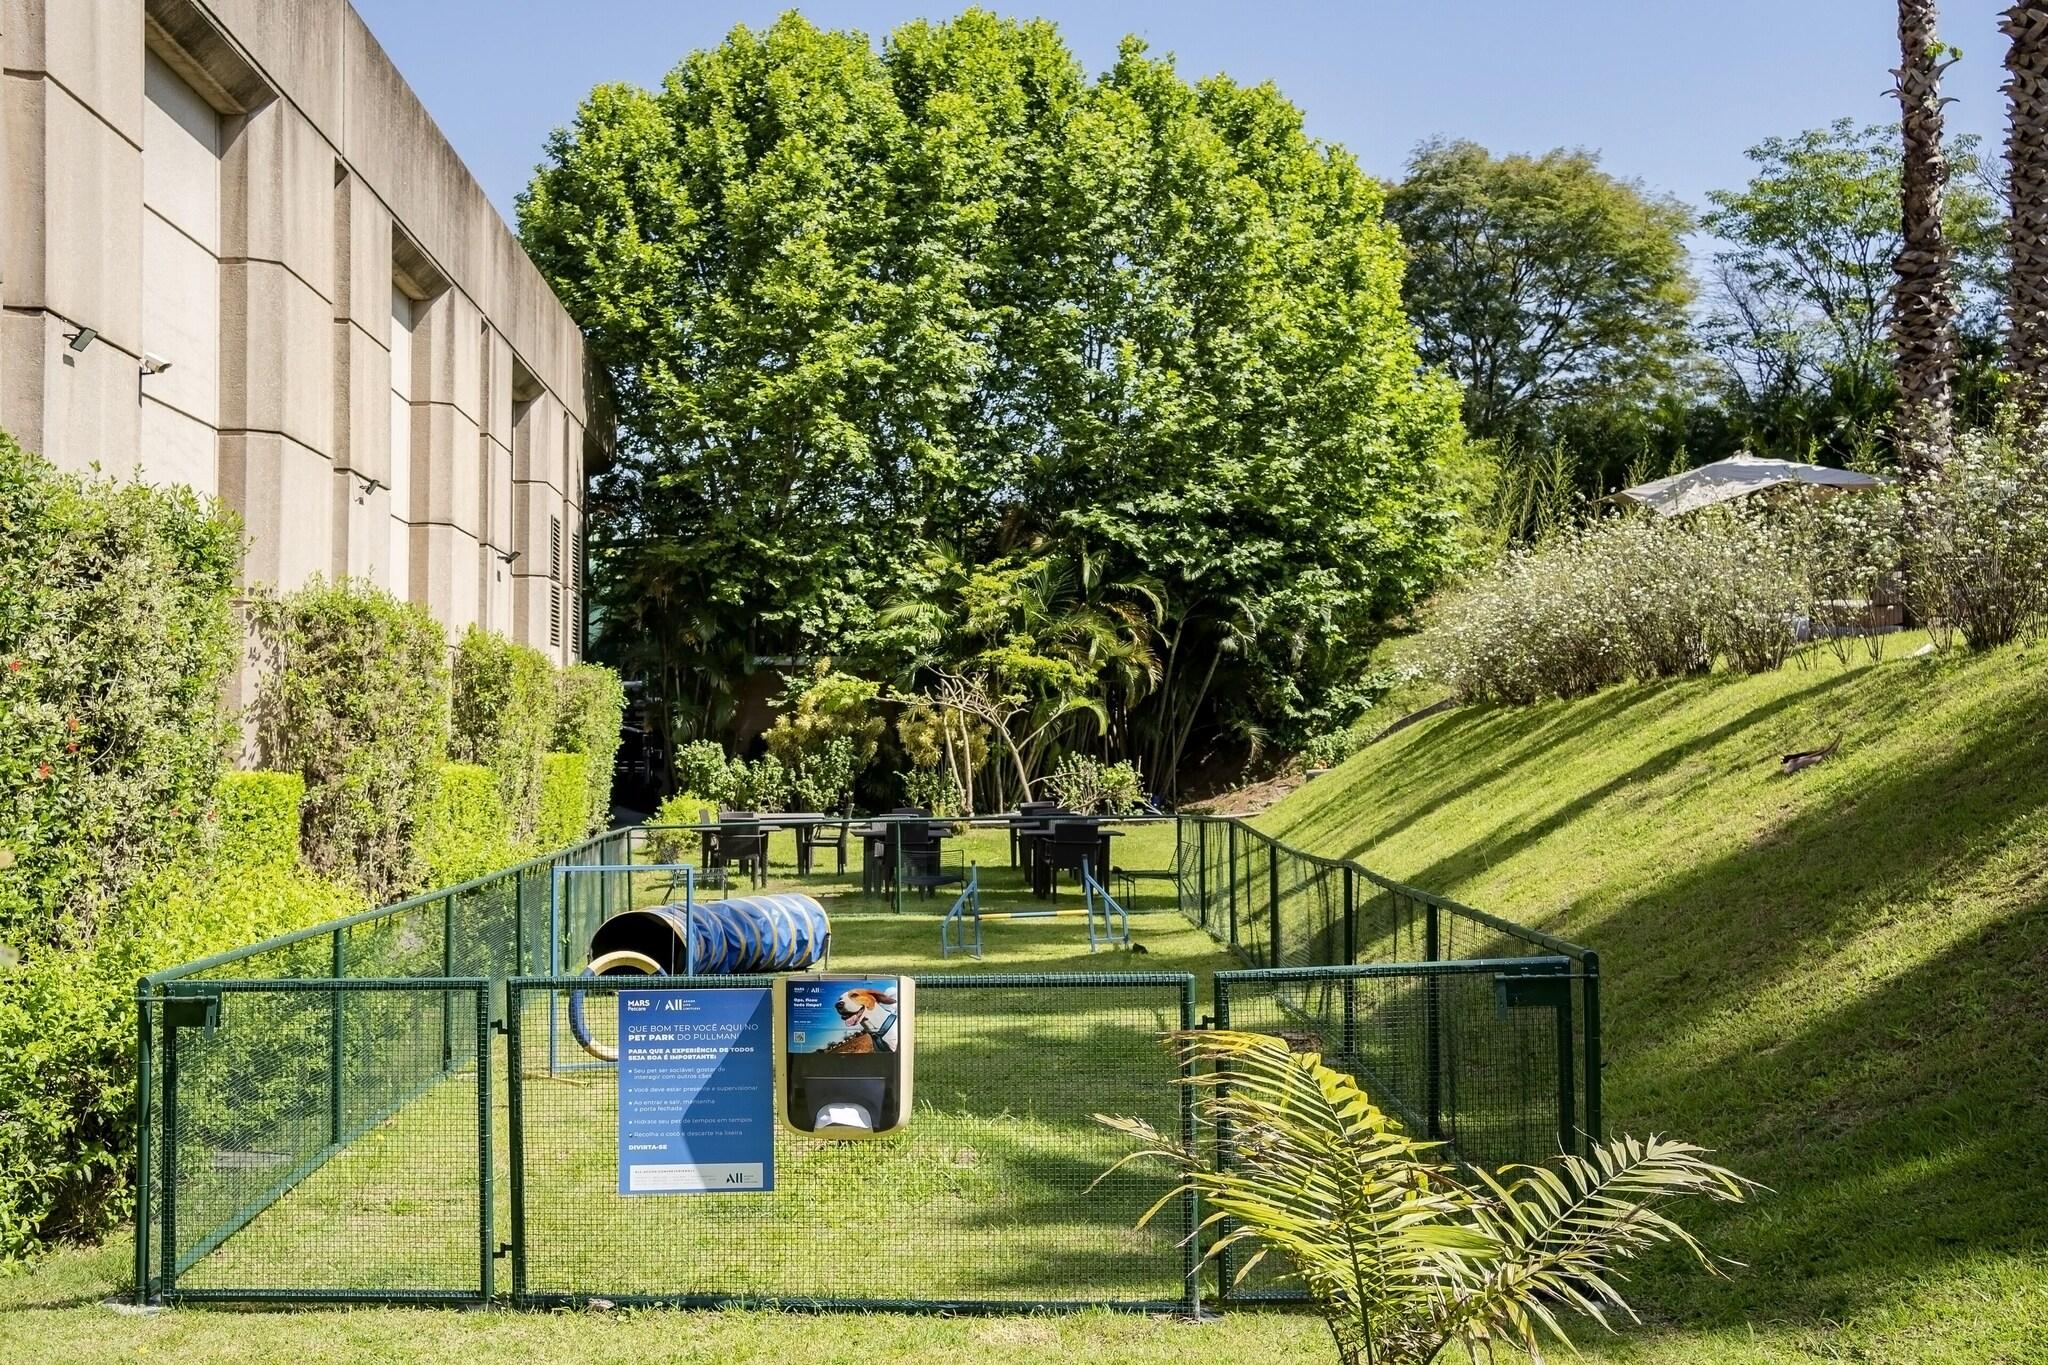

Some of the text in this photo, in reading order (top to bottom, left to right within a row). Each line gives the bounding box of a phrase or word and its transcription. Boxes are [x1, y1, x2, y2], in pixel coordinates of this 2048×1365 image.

[628, 999, 650, 1007] MARS
[665, 999, 682, 1011] All
[628, 1025, 648, 1033] QUE
[692, 1023, 717, 1031] VOCÊ
[719, 1024, 743, 1032] AQUI
[726, 1172, 743, 1183] All
